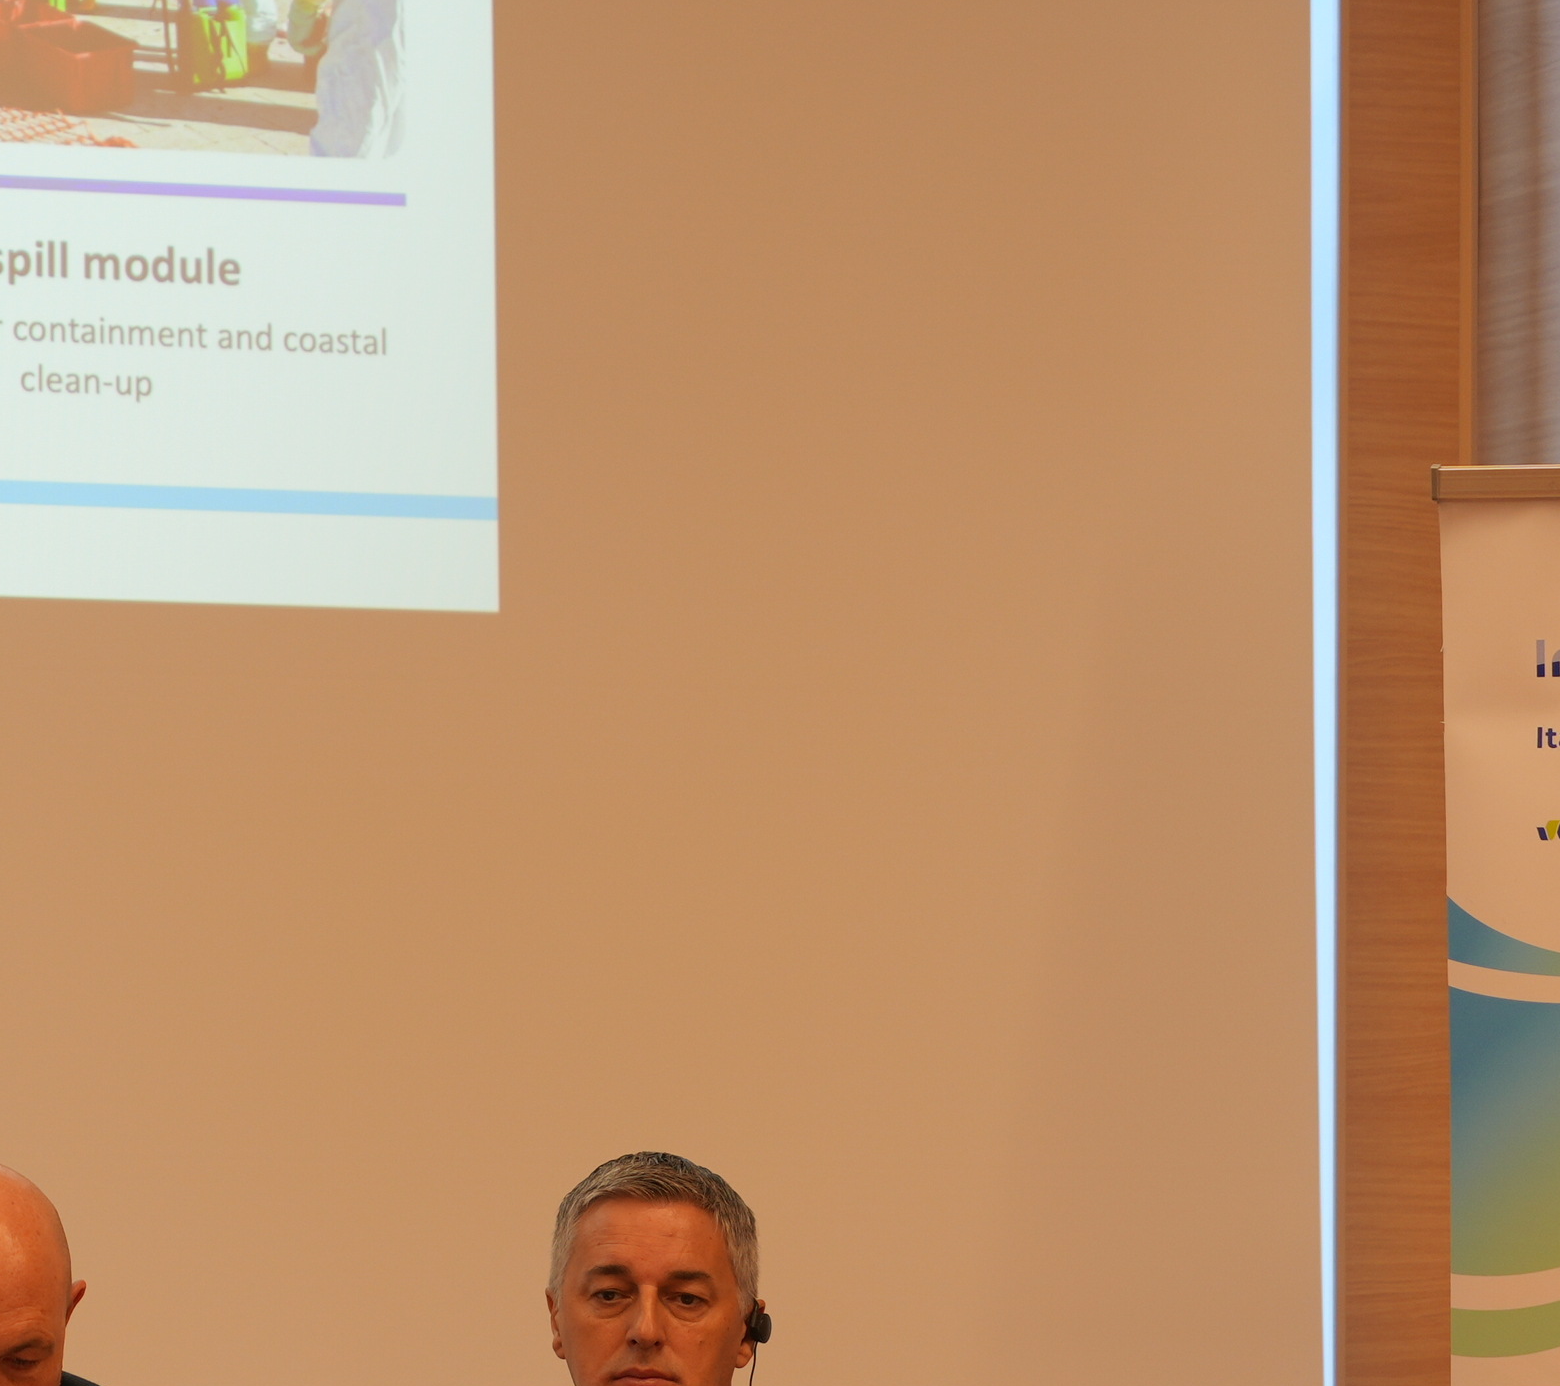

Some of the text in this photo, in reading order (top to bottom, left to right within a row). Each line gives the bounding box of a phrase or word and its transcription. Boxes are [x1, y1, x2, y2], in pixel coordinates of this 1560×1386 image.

[82, 246, 242, 286] module
[12, 317, 209, 349] containment
[217, 322, 274, 352] and
[282, 327, 389, 357] coastal
[19, 364, 153, 403] clean-up
